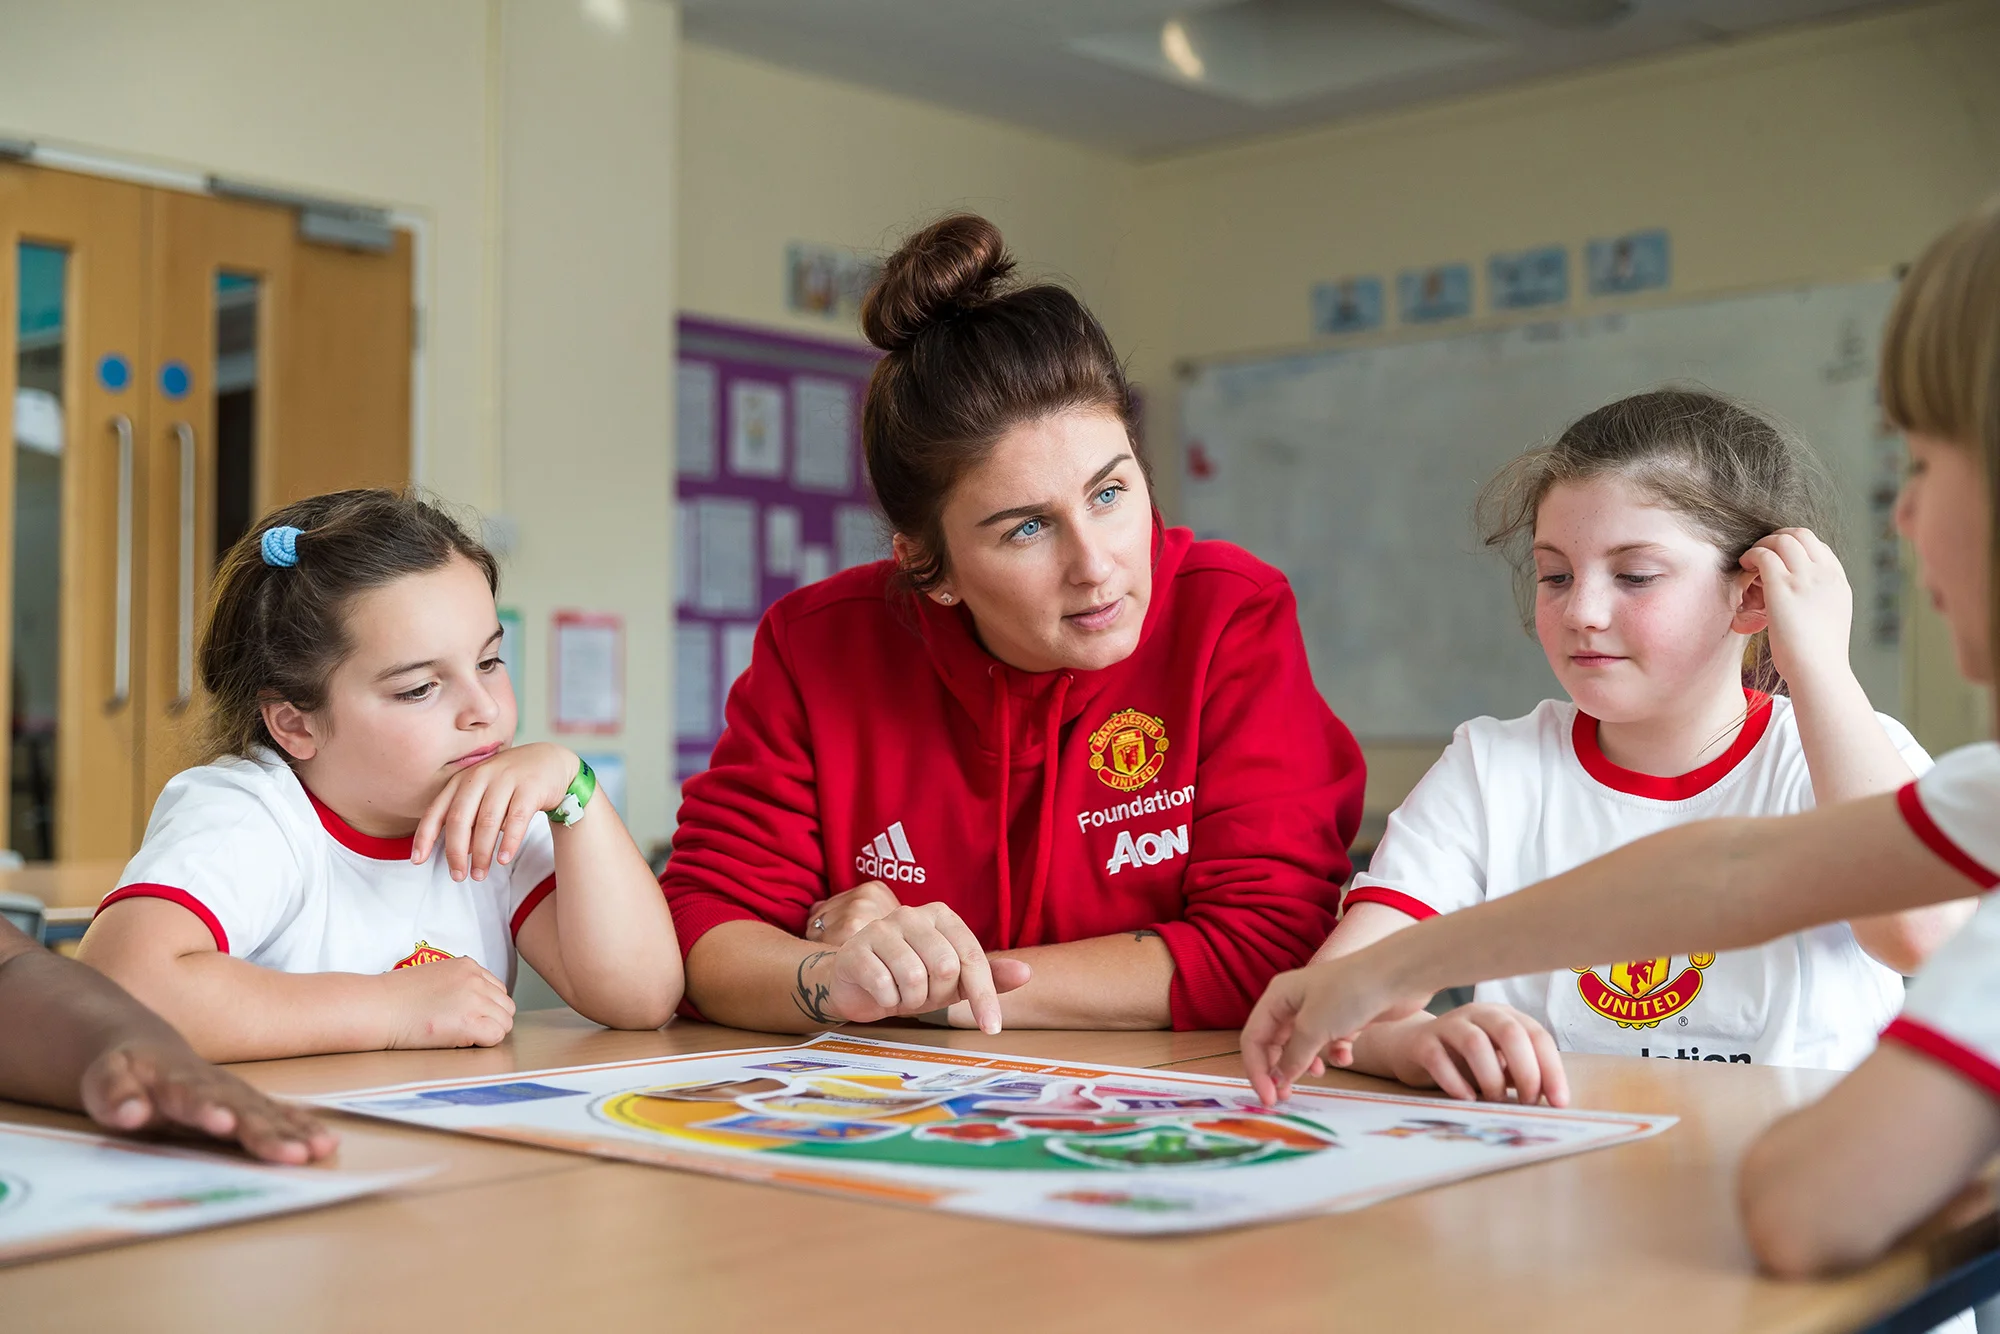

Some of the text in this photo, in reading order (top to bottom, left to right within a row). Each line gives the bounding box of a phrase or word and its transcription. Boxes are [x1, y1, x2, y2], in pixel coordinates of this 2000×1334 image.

[1096, 714, 1159, 748] MANCHESTER
[1111, 767, 1155, 787] UNITED
[1077, 784, 1195, 833] Foundation
[1106, 823, 1190, 876] AON
[856, 856, 926, 884] adidas
[1598, 990, 1681, 1017] UNITED
